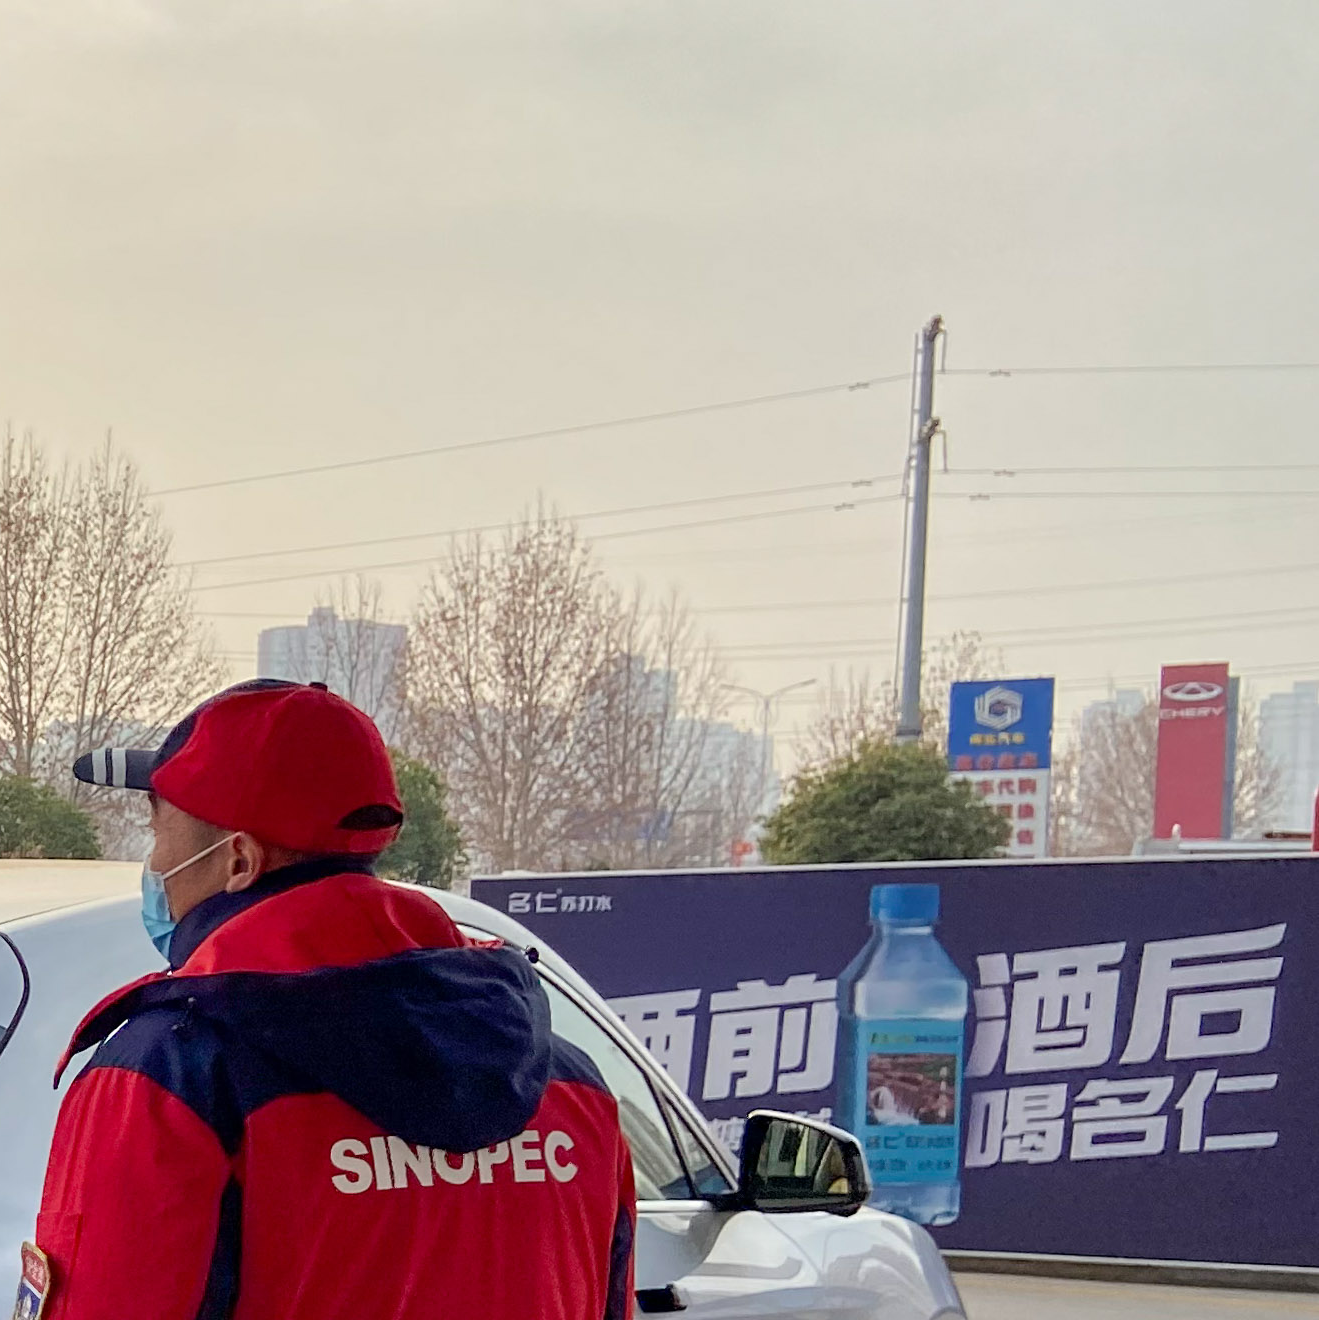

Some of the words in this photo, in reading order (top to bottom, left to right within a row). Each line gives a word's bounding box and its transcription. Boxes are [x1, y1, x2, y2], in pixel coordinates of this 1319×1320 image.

[1160, 705, 1226, 721] CHERY
[963, 922, 1288, 1080] 酒后
[964, 1068, 1280, 1170] 喝名仁
[329, 1129, 579, 1195] SINOPEC
